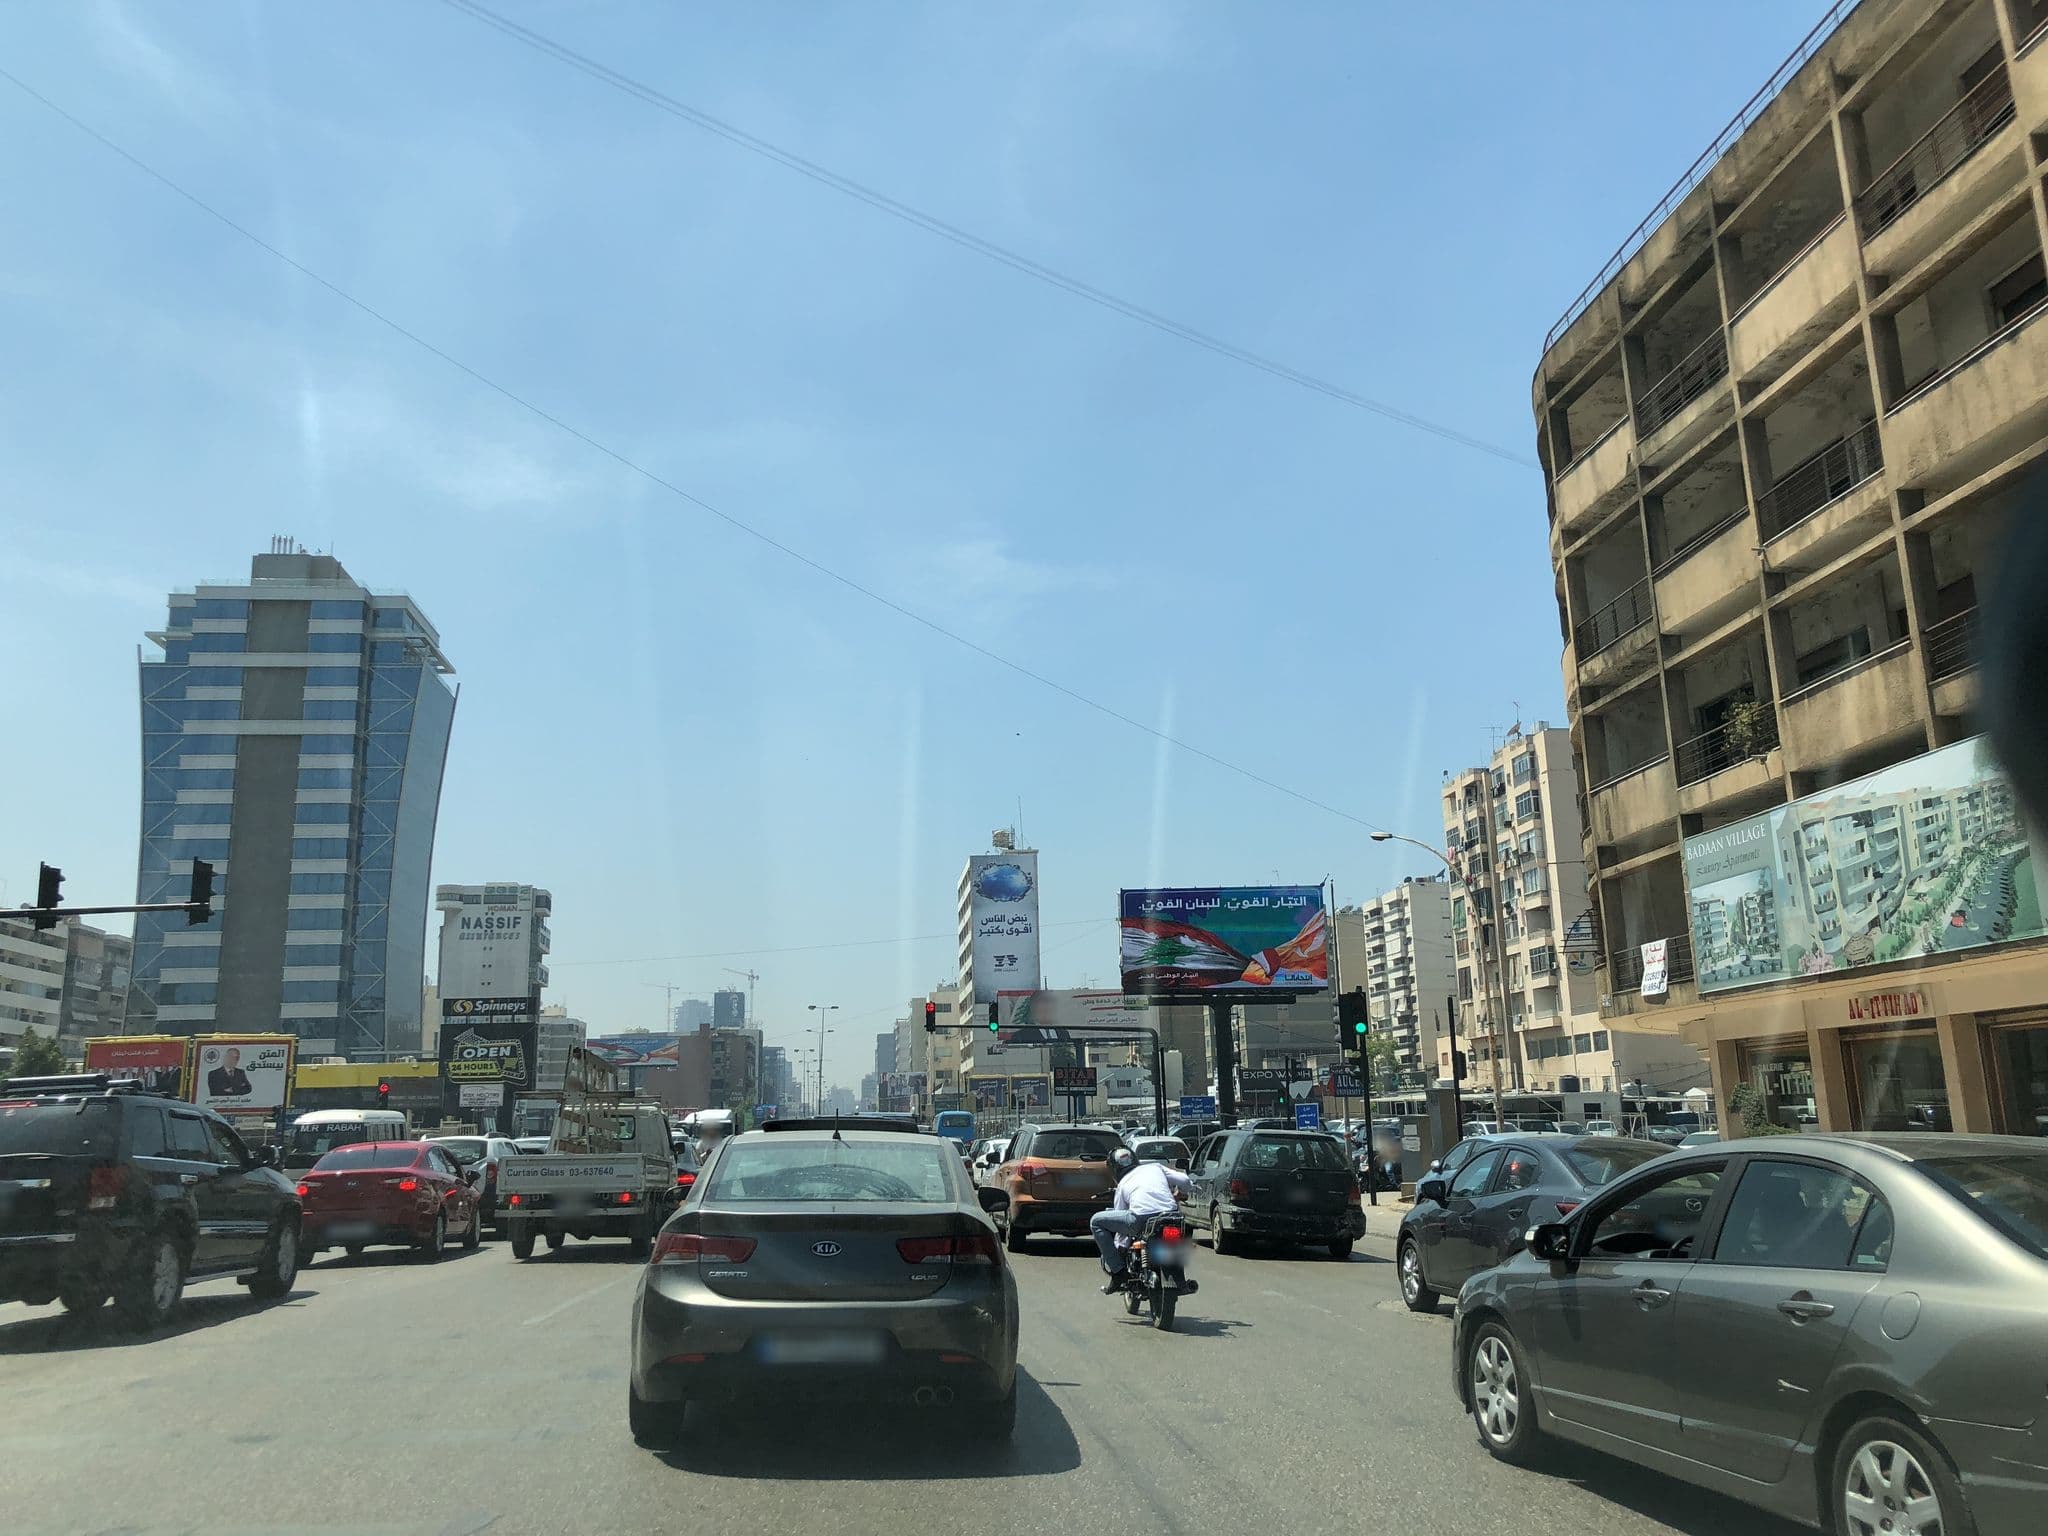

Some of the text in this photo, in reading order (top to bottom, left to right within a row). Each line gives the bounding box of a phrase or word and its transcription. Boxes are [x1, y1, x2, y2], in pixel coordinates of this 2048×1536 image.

[1686, 823, 1766, 860] BADAAN VILLAGE
[1722, 848, 1761, 870] Apartments
[1185, 898, 1220, 910] للبنان
[460, 916, 522, 930] NASSIF
[981, 913, 1028, 926] نبض الناس
[459, 932, 521, 940] assurances
[474, 1000, 527, 1013] Spinneys
[1848, 992, 1919, 1019] AL-ITTIHAD
[258, 1049, 285, 1060] المتن
[462, 1046, 512, 1058] OPEN
[451, 1063, 495, 1072] 24 HOURS
[1055, 1068, 1095, 1079] BITAR
[1242, 1071, 1274, 1079] EXPO
[326, 1123, 362, 1132] RABAH
[507, 1168, 539, 1177] Curtain
[540, 1168, 565, 1177] Glass
[816, 1244, 837, 1253] KIA
